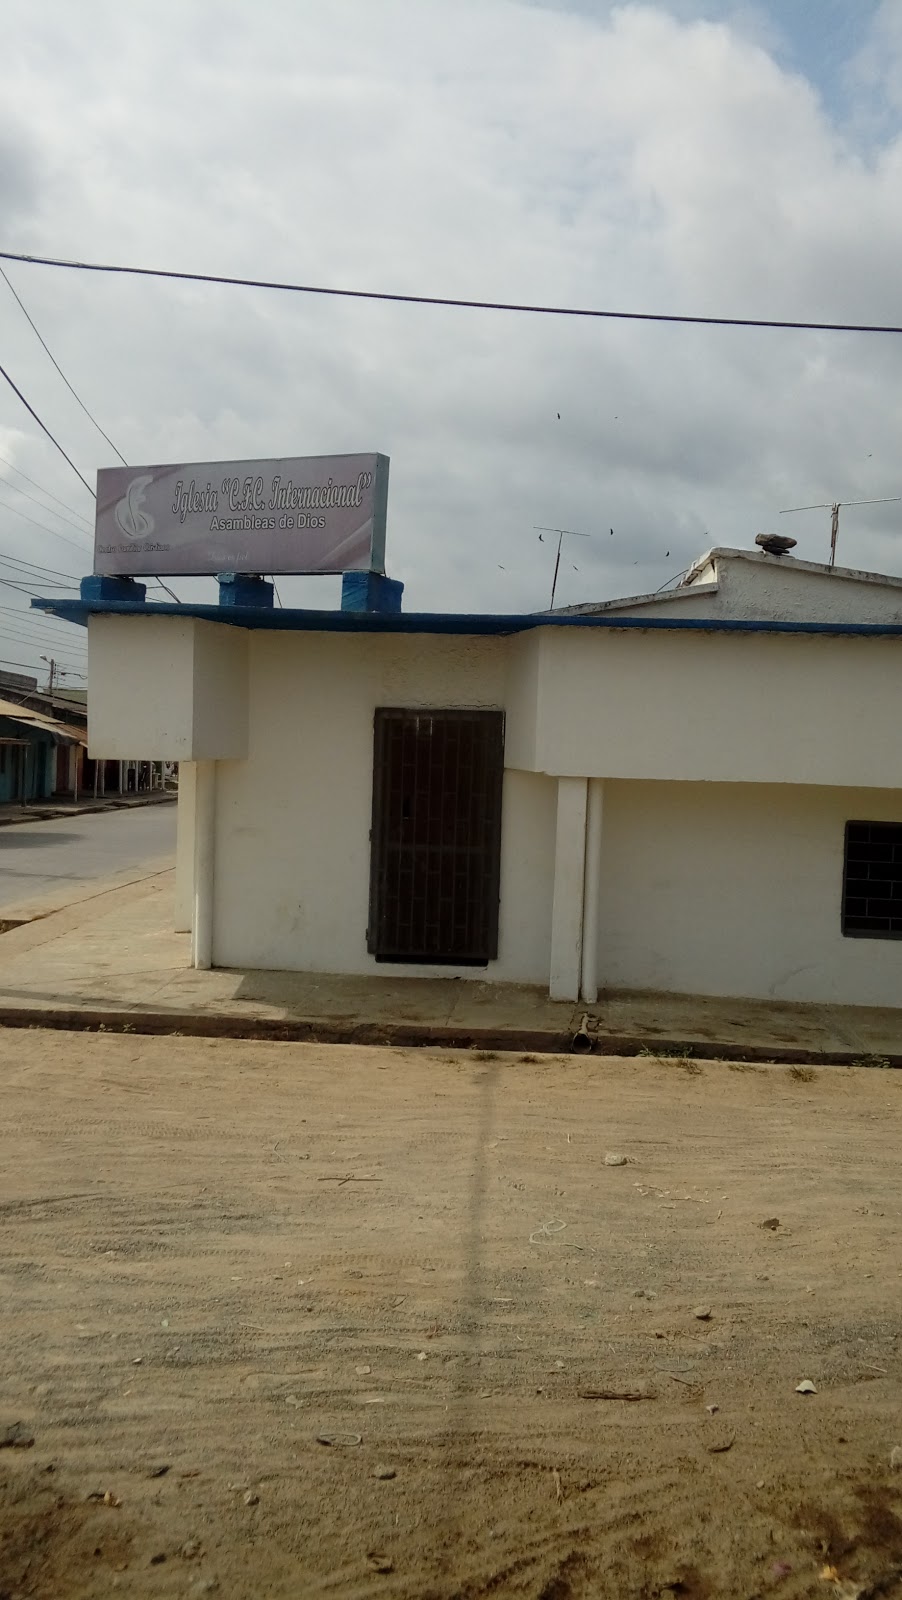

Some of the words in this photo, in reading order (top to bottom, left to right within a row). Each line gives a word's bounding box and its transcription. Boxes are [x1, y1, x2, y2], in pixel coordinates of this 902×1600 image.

[172, 480, 218, 523] Iglesia
[210, 515, 275, 531] Asambleas
[279, 513, 294, 529] de
[297, 512, 327, 529] Dios
